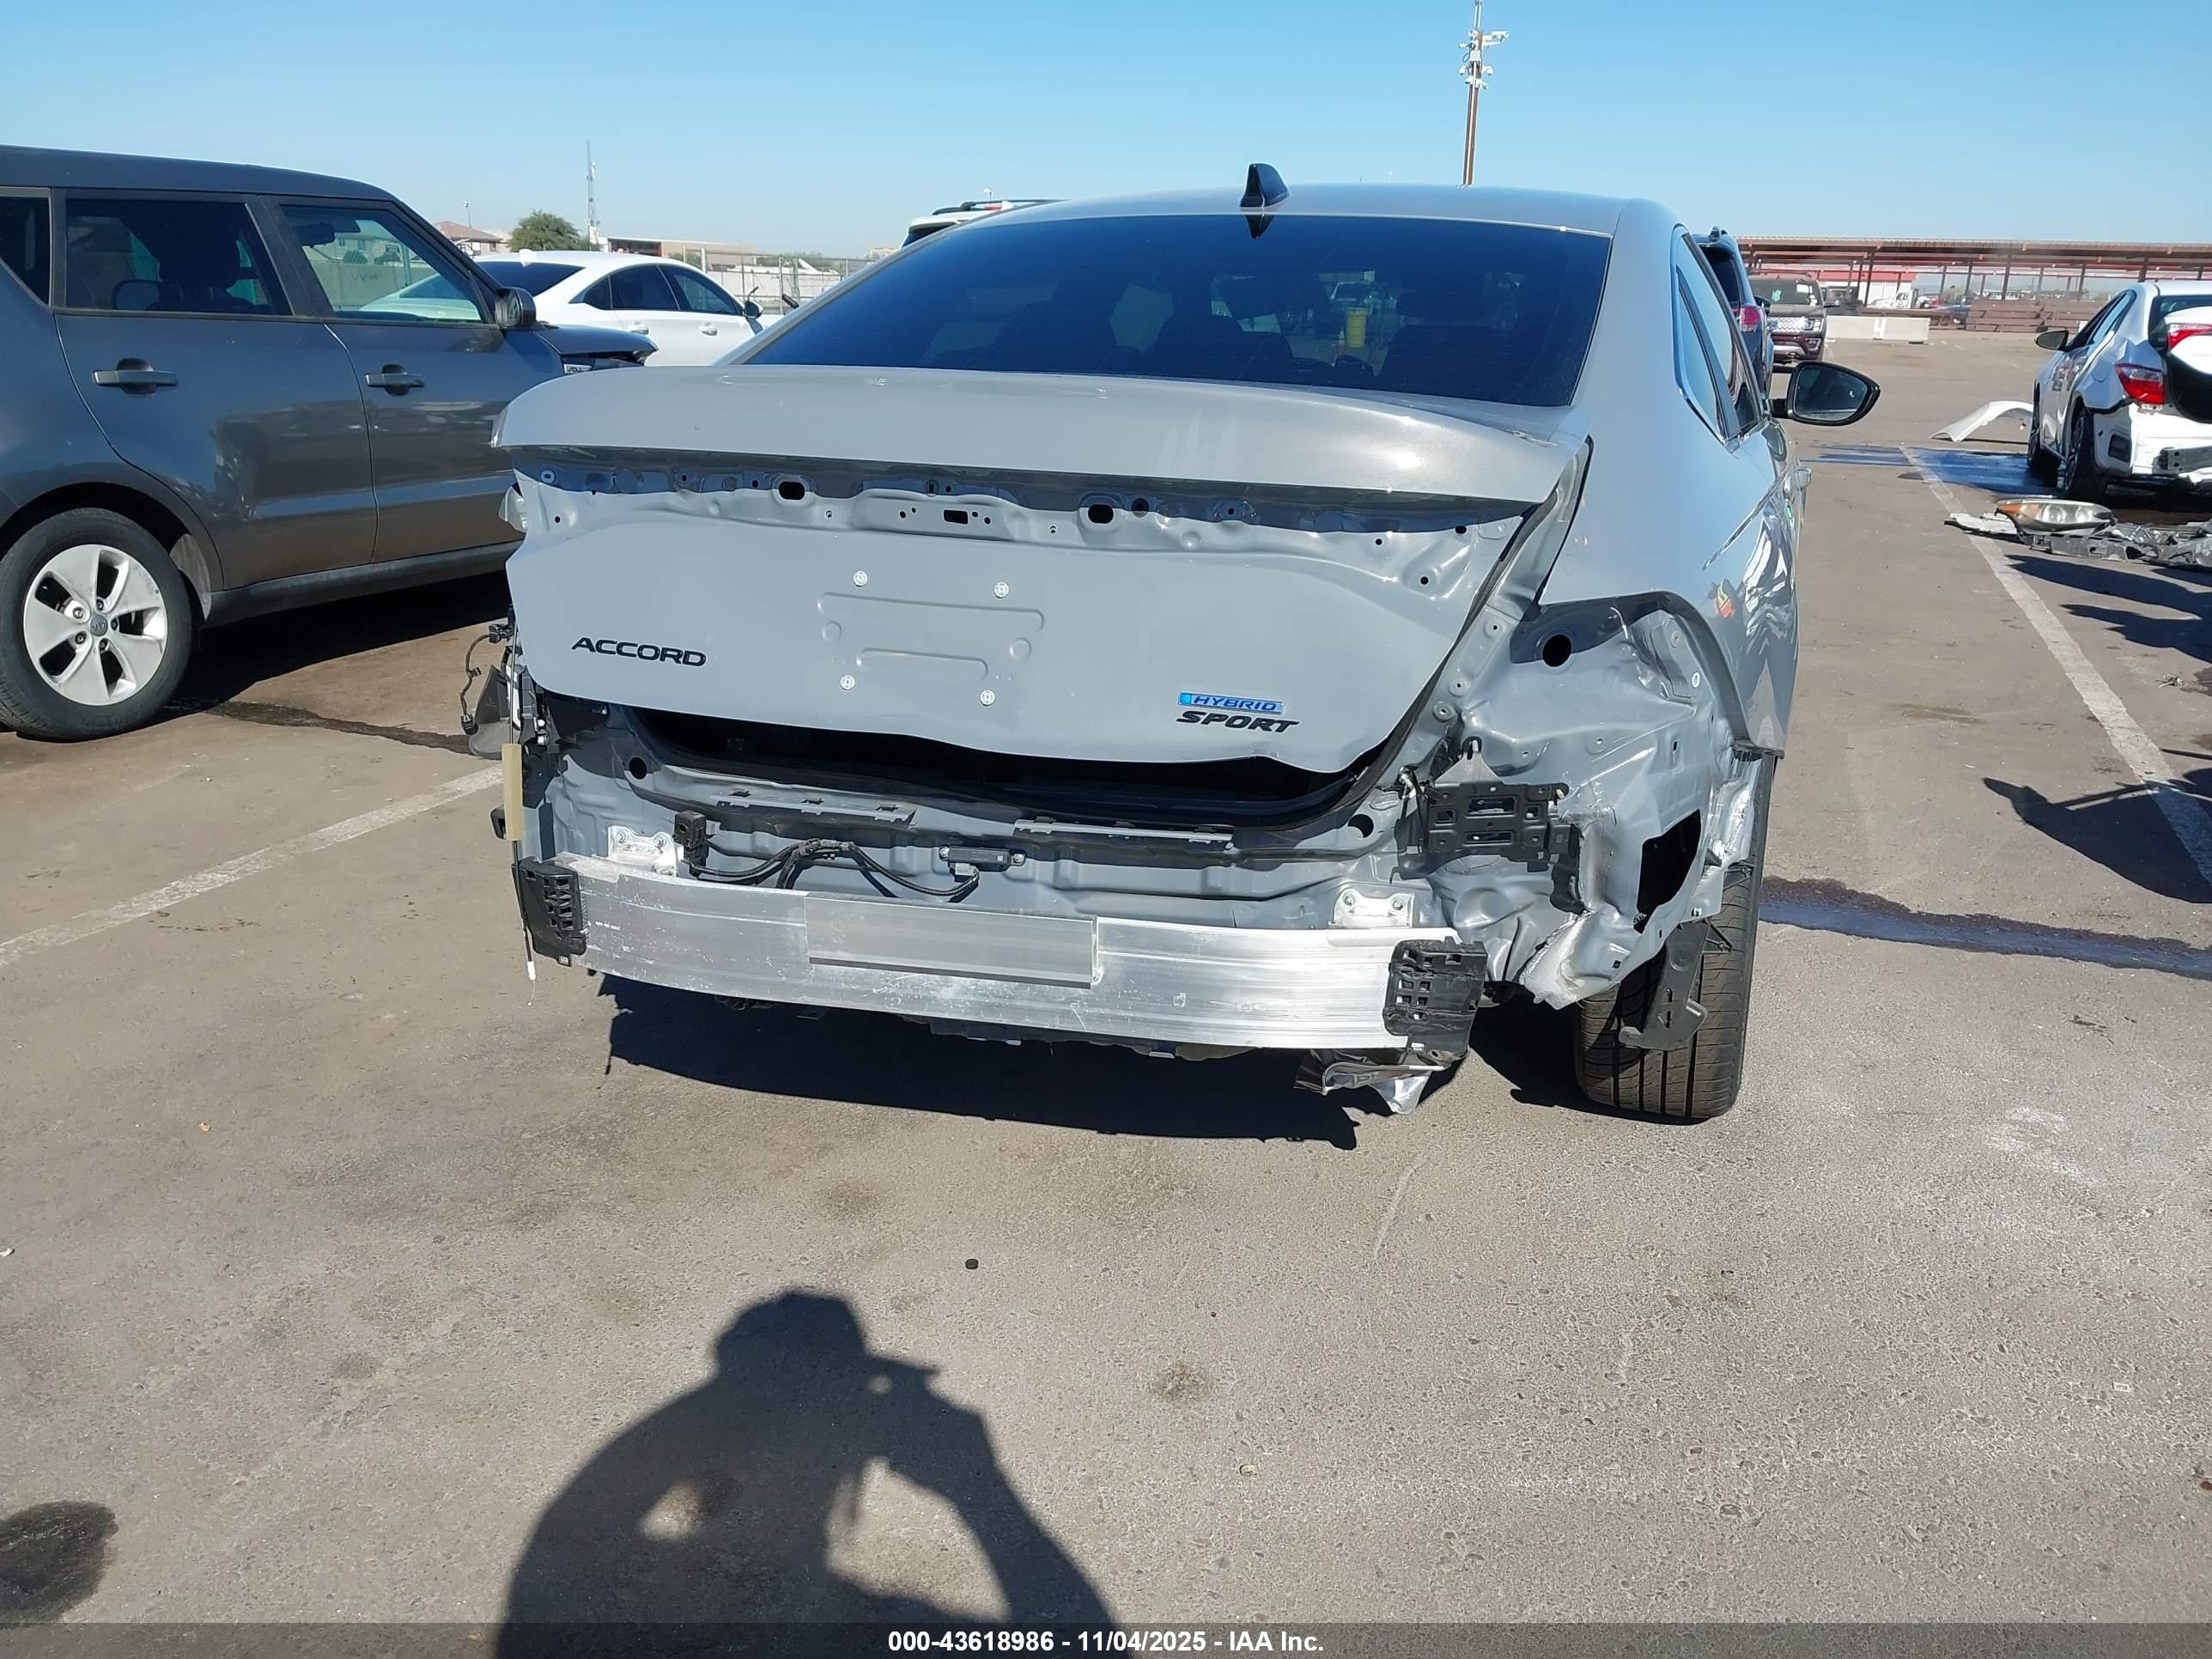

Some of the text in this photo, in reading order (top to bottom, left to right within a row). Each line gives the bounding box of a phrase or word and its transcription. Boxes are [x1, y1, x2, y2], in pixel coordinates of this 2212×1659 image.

[571, 637, 707, 667] ACCORD
[1194, 695, 1277, 711] HYBRID
[1176, 710, 1300, 732] SPORT
